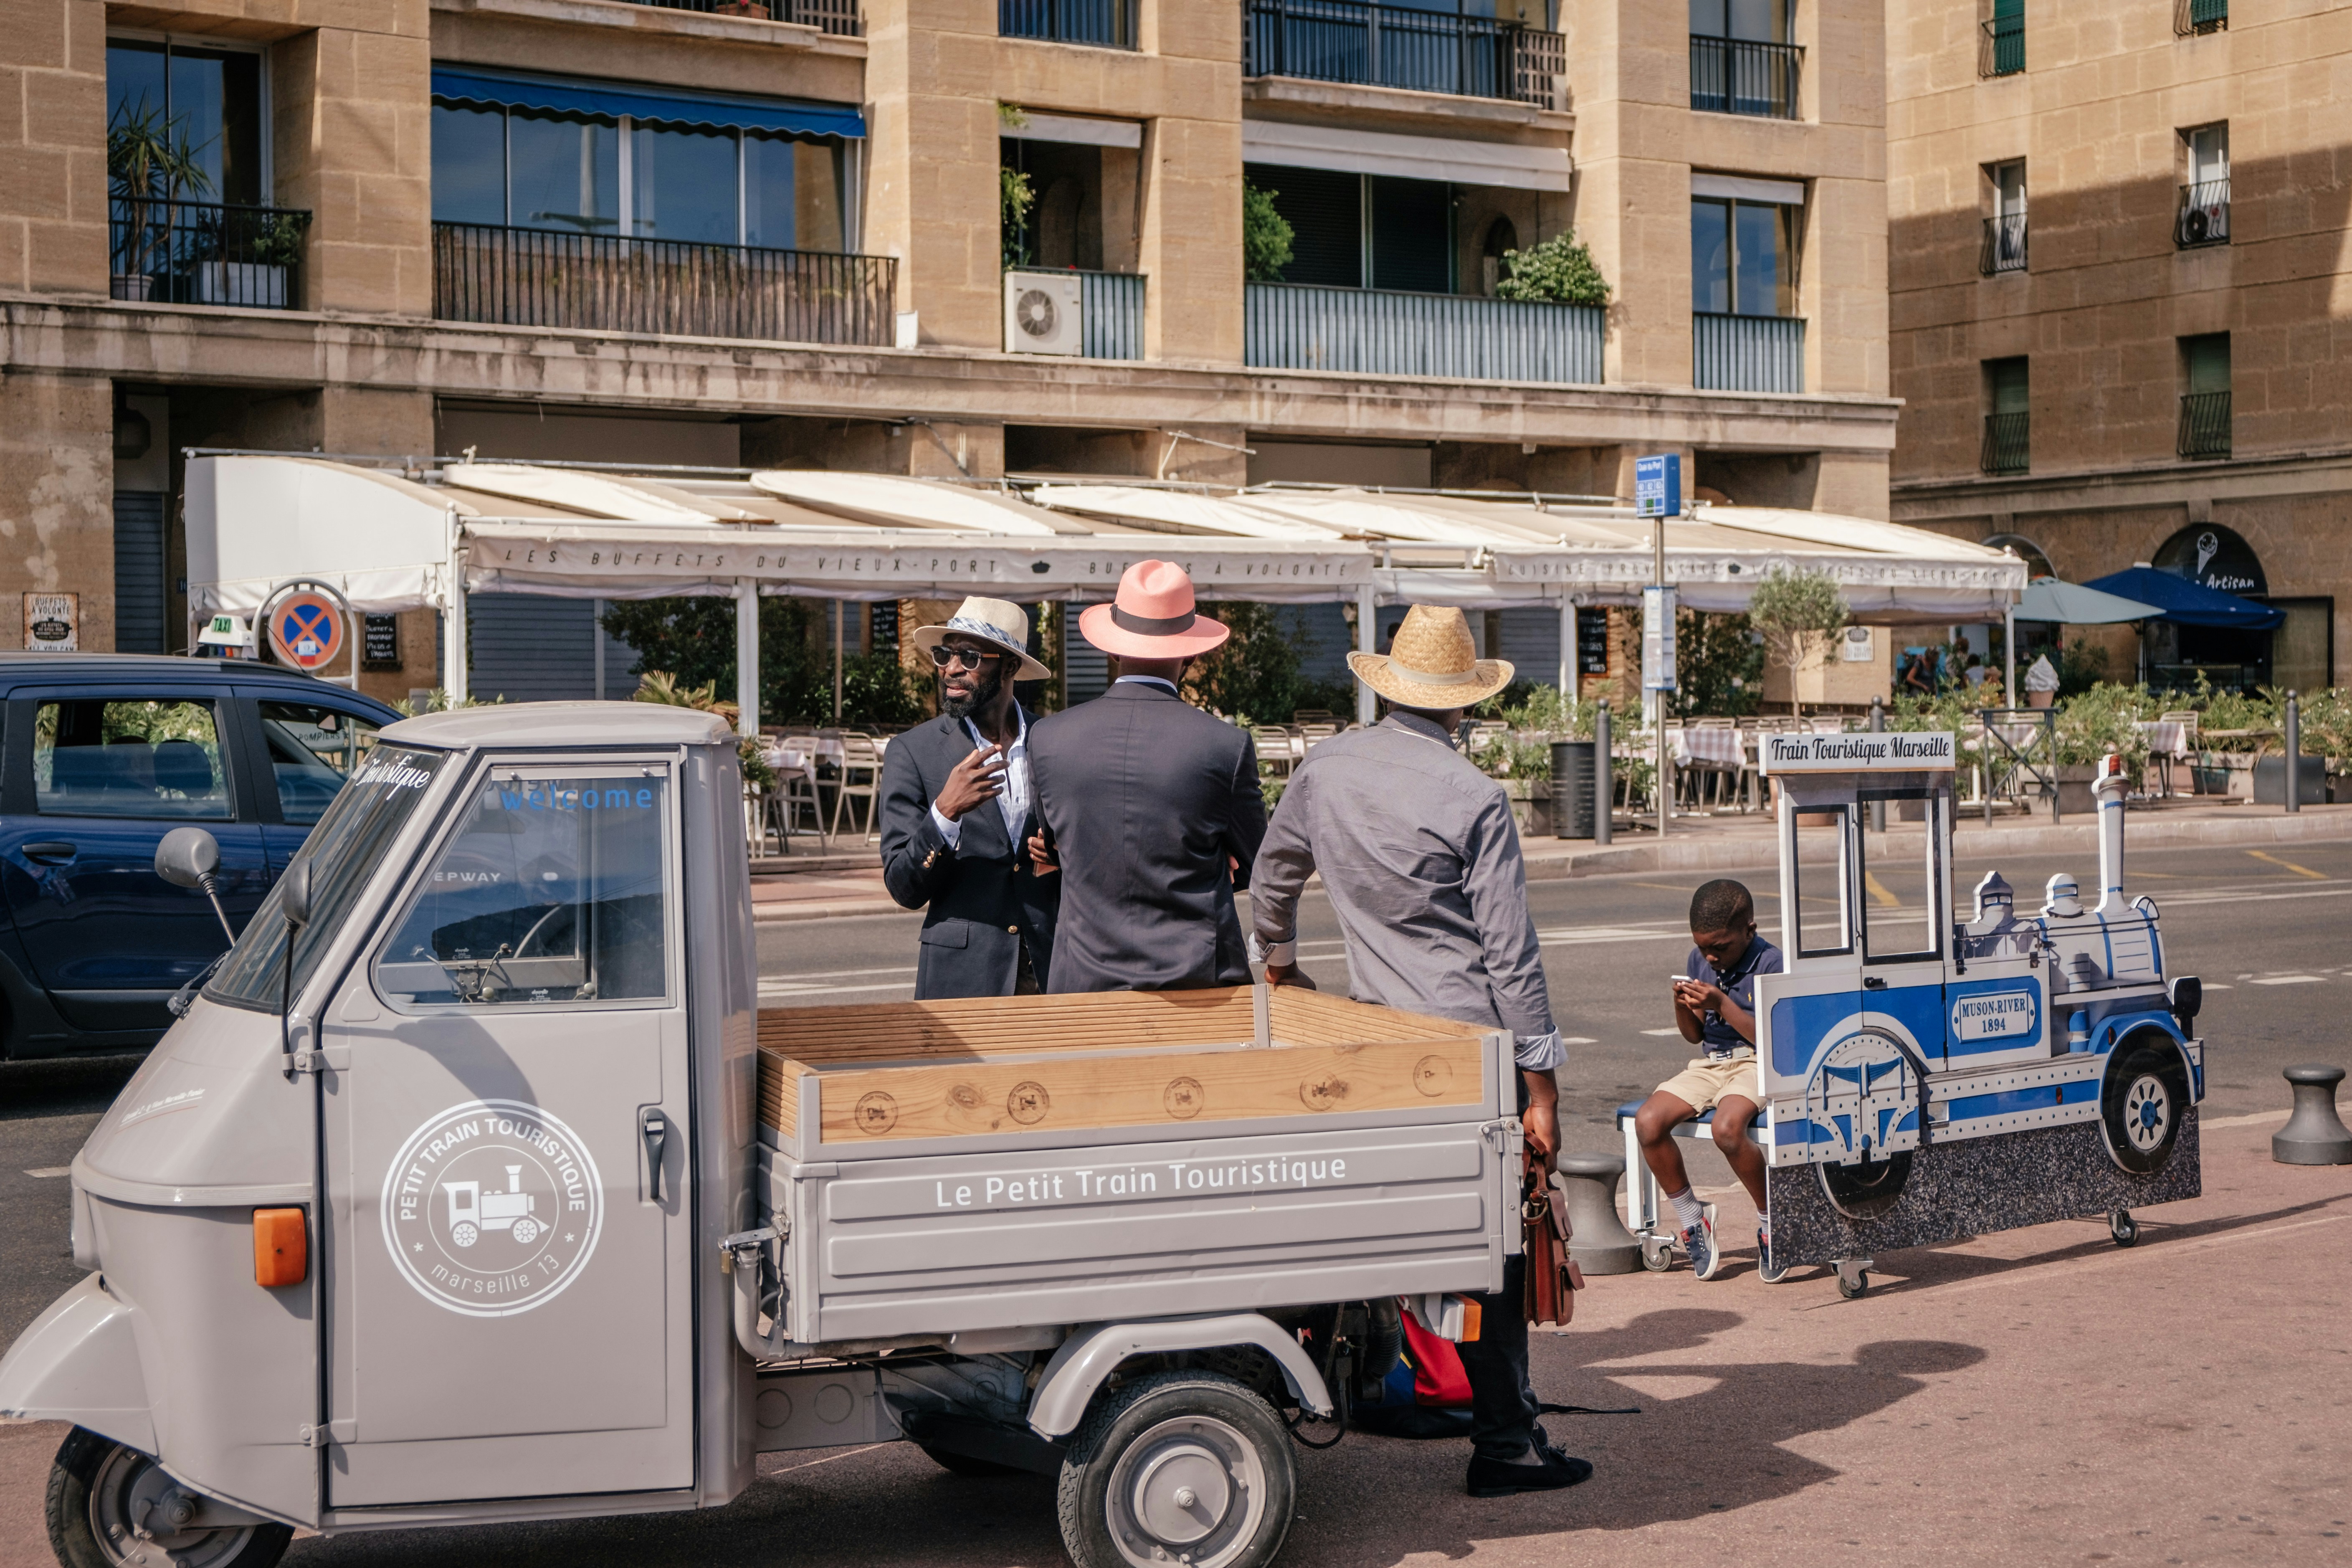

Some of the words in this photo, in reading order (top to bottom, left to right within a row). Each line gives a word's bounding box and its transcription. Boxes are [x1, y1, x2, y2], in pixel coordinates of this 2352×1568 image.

[505, 550, 557, 563] LES
[591, 552, 724, 567] BUFFETS
[757, 556, 786, 568] DU
[819, 557, 995, 572] VIEUX-PORT
[1089, 562, 1192, 574] BUFS
[1215, 560, 1221, 575] À
[1246, 562, 1347, 576] VOLONTÉ
[1509, 563, 1585, 576] CUISINE
[1608, 563, 1718, 575] PROVNÇALE
[1880, 567, 1896, 579] DU
[2207, 573, 2254, 590] Artisan
[35, 597, 66, 606] BUFFETS
[214, 618, 231, 632] TAXI
[298, 732, 340, 742] POMPIERS
[1771, 738, 1809, 760] Train
[1812, 738, 1887, 765] Touristique
[1890, 737, 1949, 758] Marseille
[355, 755, 430, 800] Touristique
[501, 783, 652, 811] welcome
[1982, 1017, 2006, 1033] 1894
[400, 1163, 427, 1220] PETIT
[419, 1120, 480, 1163] TRAIN
[484, 1118, 585, 1211] TOURISTIQUE
[936, 1181, 972, 1207] Le
[986, 1173, 1063, 1203] Petit
[1075, 1167, 1156, 1196] Train
[1169, 1156, 1346, 1187] Touristique
[431, 1264, 530, 1294] marseille
[537, 1254, 560, 1275] 13
